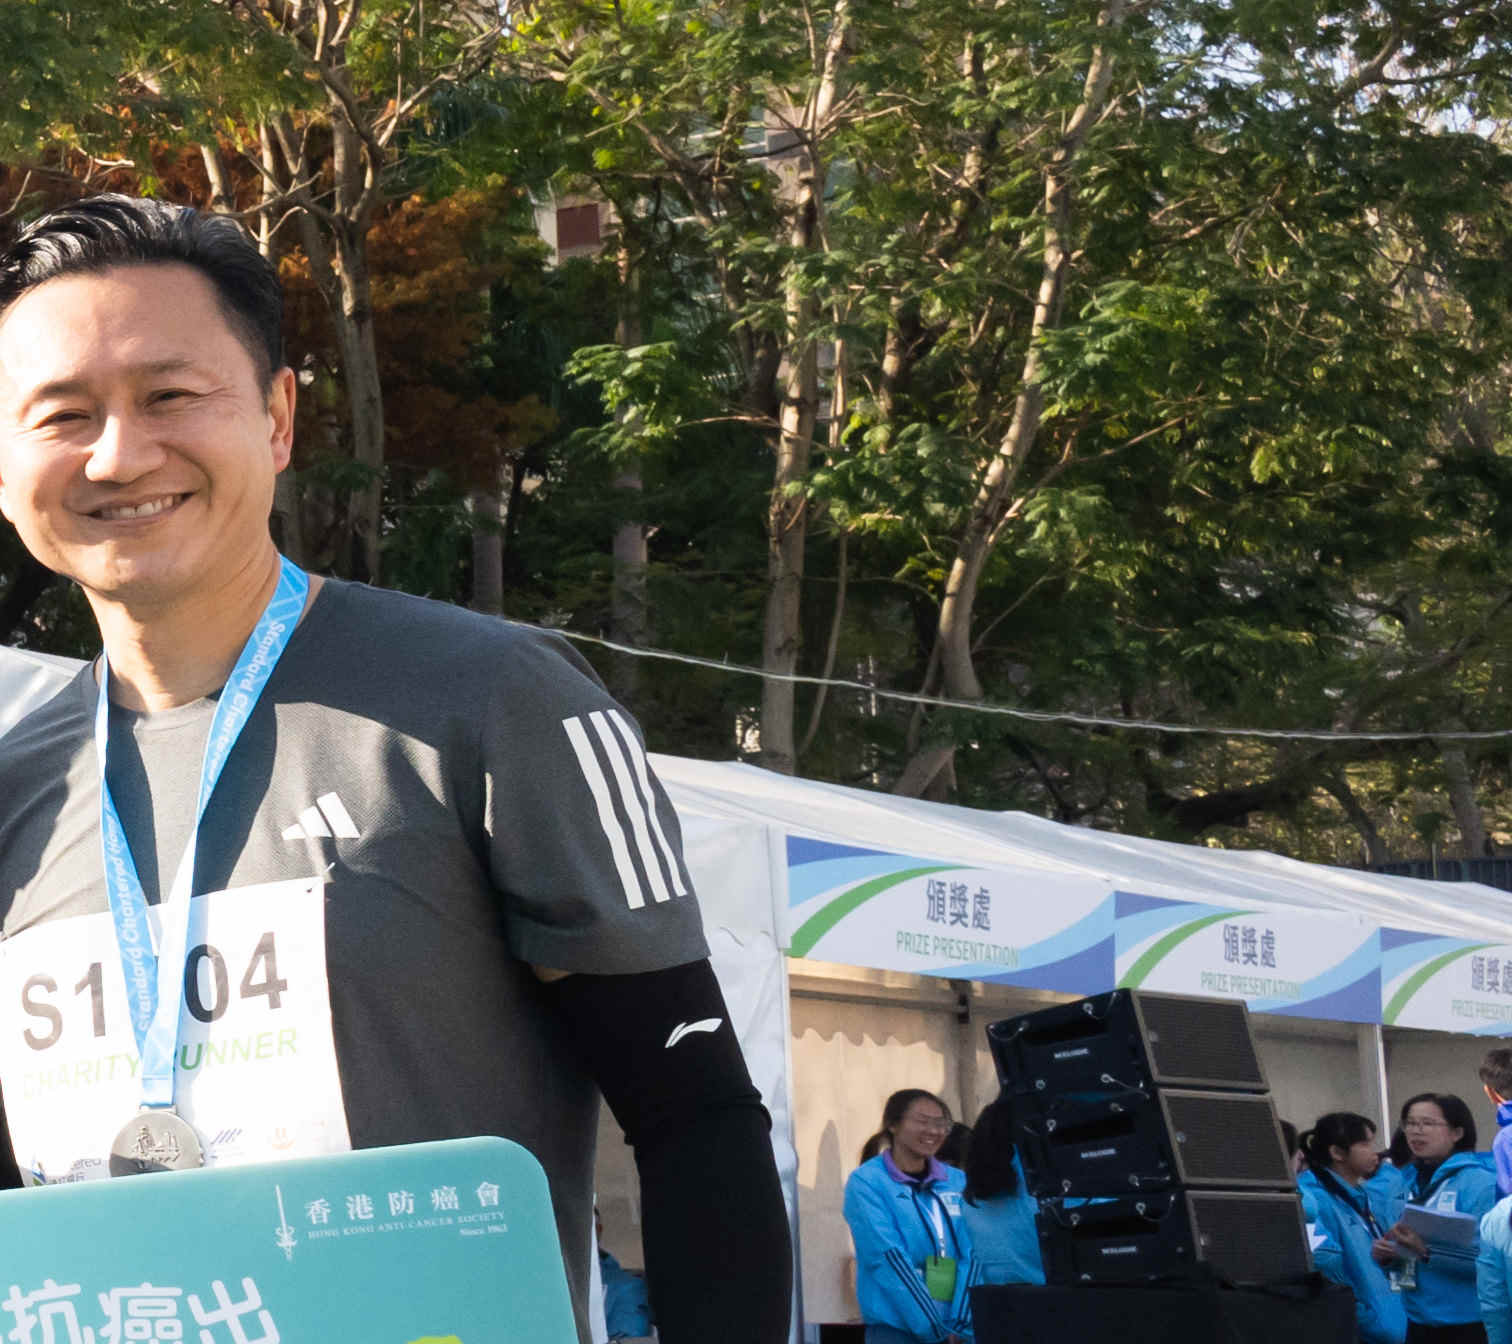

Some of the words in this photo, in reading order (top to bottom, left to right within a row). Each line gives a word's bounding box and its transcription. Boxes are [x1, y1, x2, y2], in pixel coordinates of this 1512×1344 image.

[925, 878, 992, 932] 頒獎處
[895, 929, 931, 957] PRIZE
[932, 935, 1019, 968] PRESENTATION
[178, 1027, 298, 1073] UNNER
[304, 1181, 500, 1225] 香港防癌會
